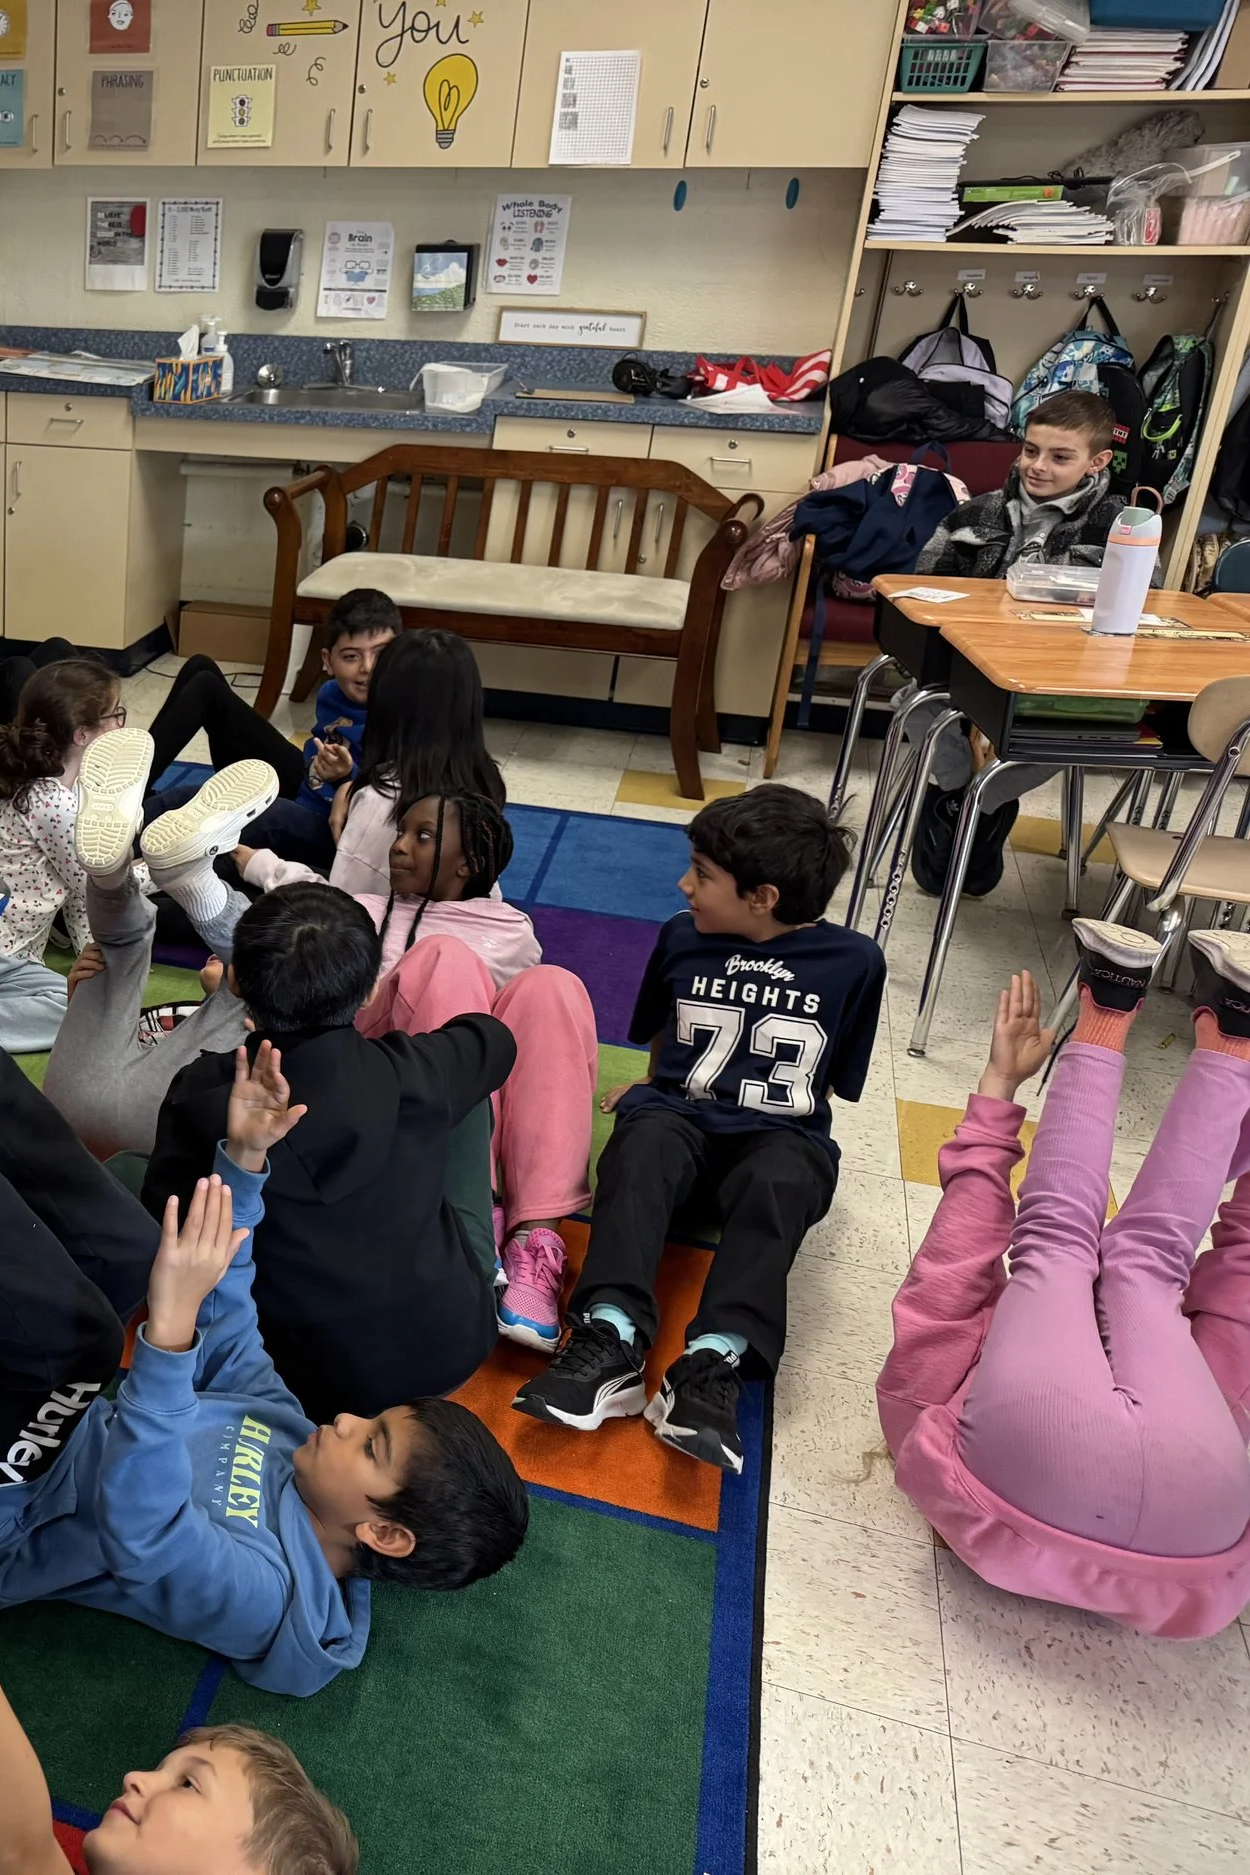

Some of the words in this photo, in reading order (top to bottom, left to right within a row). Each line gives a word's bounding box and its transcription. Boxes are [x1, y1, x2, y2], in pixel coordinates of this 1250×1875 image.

[101, 74, 144, 88] PHRASING
[213, 67, 273, 82] PUNCTUATION
[502, 199, 534, 211] Whole
[538, 200, 563, 214] Body
[513, 209, 553, 218] LISTENING
[348, 233, 373, 243] Brain
[578, 321, 607, 336] grateful
[1114, 429, 1128, 437] TNT
[724, 953, 796, 983] Brooklyn
[691, 976, 821, 1015] HEIGHTS
[676, 998, 828, 1118] 73
